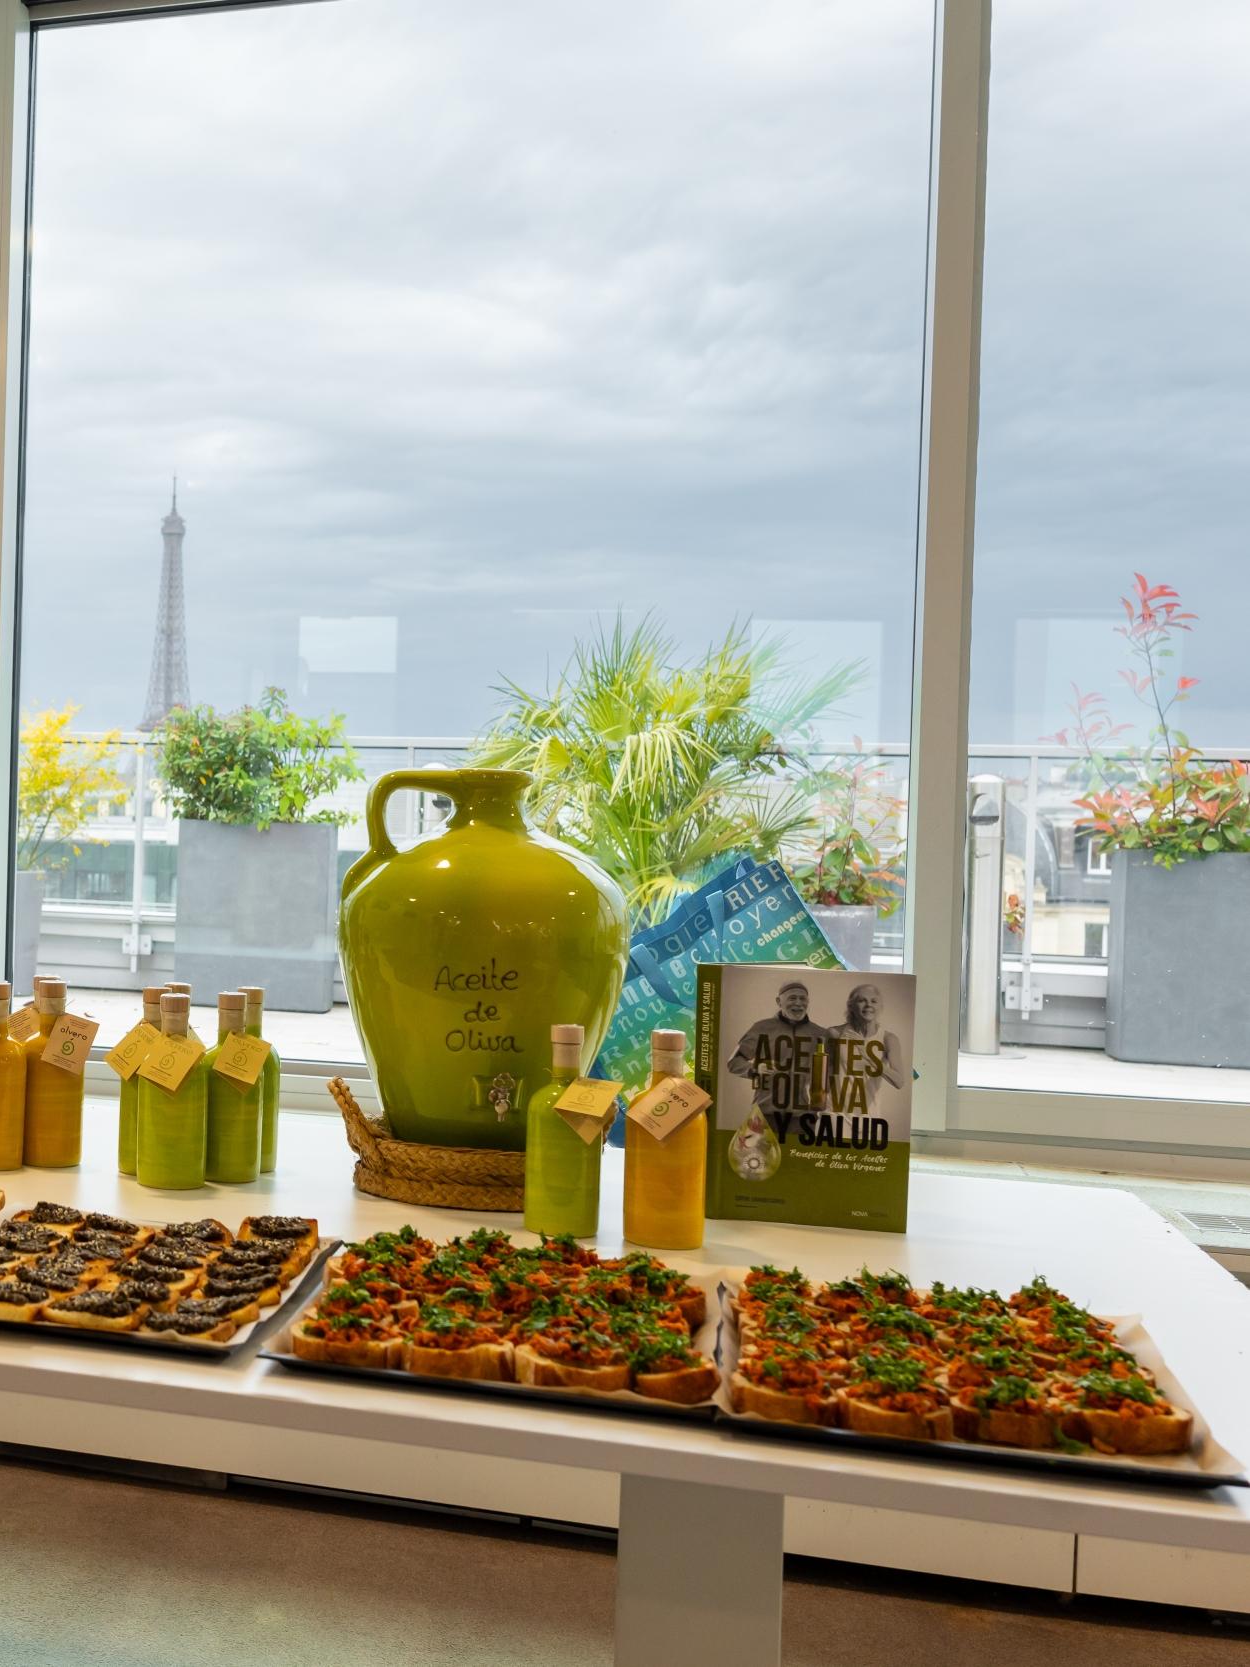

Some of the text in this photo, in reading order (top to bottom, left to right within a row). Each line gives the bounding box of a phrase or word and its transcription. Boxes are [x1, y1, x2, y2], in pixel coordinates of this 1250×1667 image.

[434, 957, 519, 992] Aceite
[703, 982, 711, 1005] SALUD
[464, 1001, 502, 1022] de
[702, 1012, 710, 1032] OLIVA
[446, 1029, 525, 1053] Oliva
[701, 1033, 710, 1043] DE
[701, 1043, 709, 1072] ACEITES
[753, 1033, 885, 1077] ACEITES
[751, 1072, 868, 1115] DE OLIVA
[773, 1111, 889, 1151] Y SALUD
